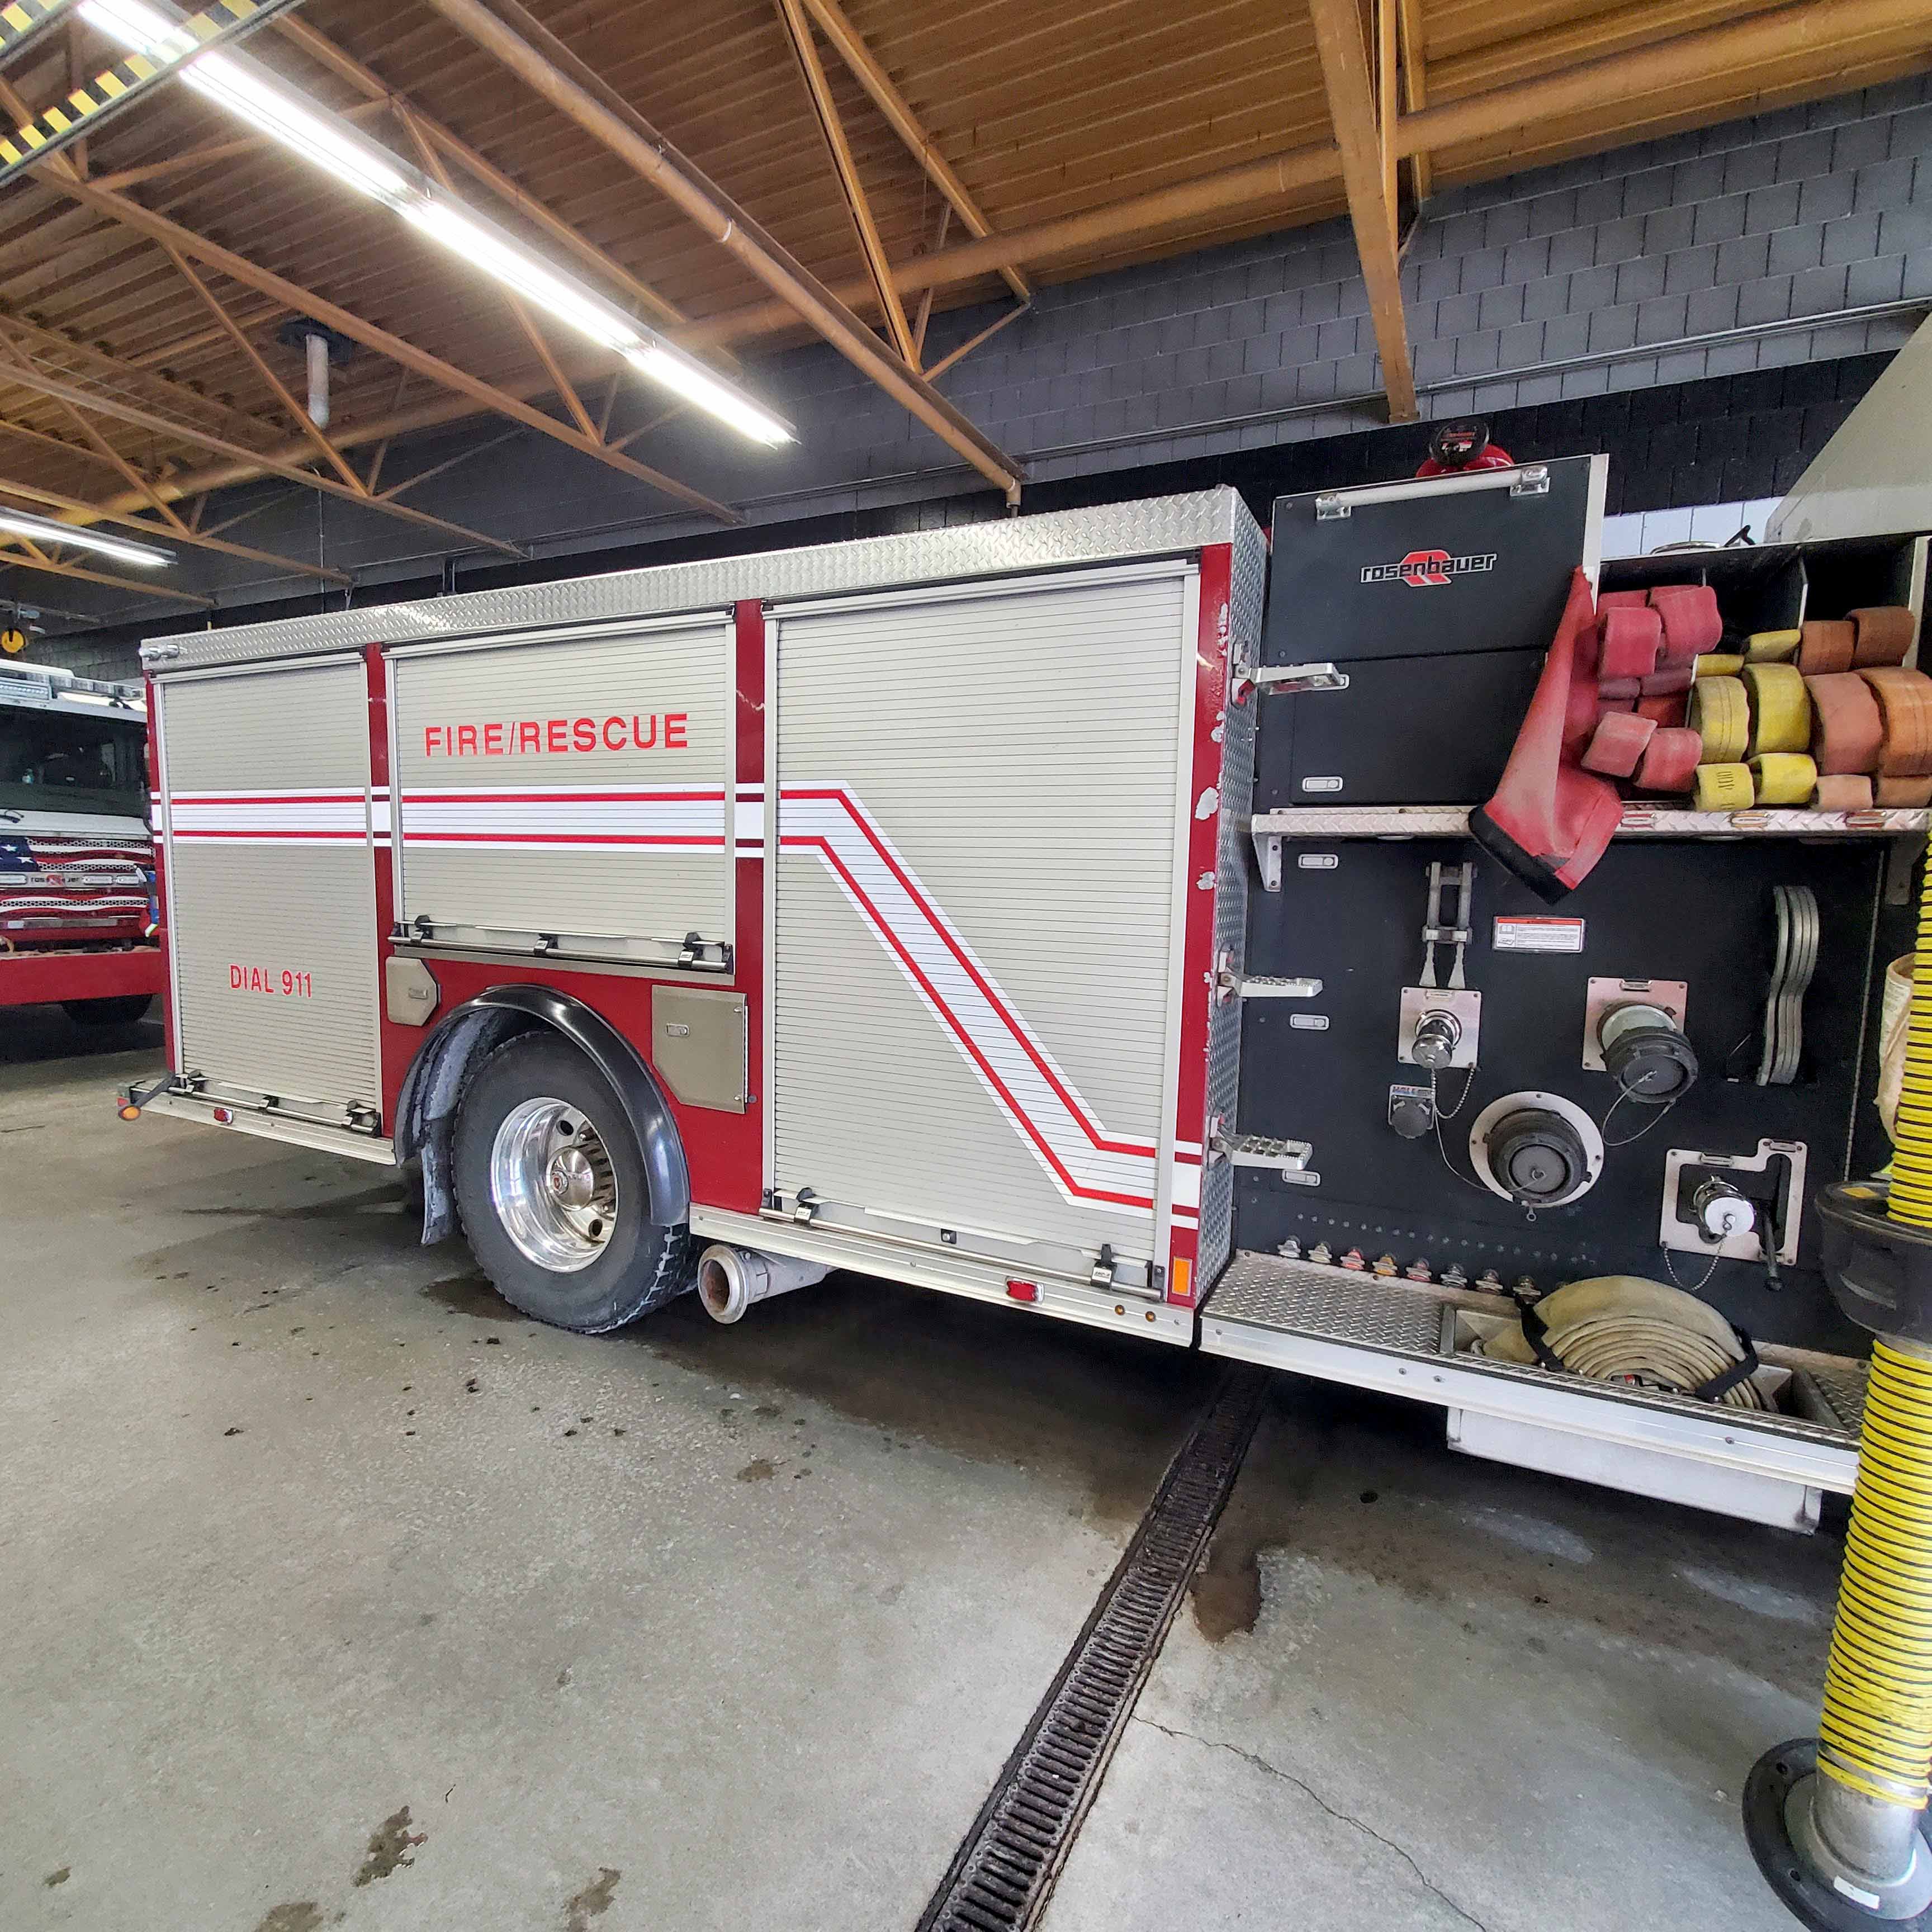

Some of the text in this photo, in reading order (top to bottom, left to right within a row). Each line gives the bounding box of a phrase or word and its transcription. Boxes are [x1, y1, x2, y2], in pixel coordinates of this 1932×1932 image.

[1362, 555, 1497, 582] rosenbauer
[424, 713, 688, 756] FIRE/RESCUE
[229, 964, 312, 998] DIAL 911
